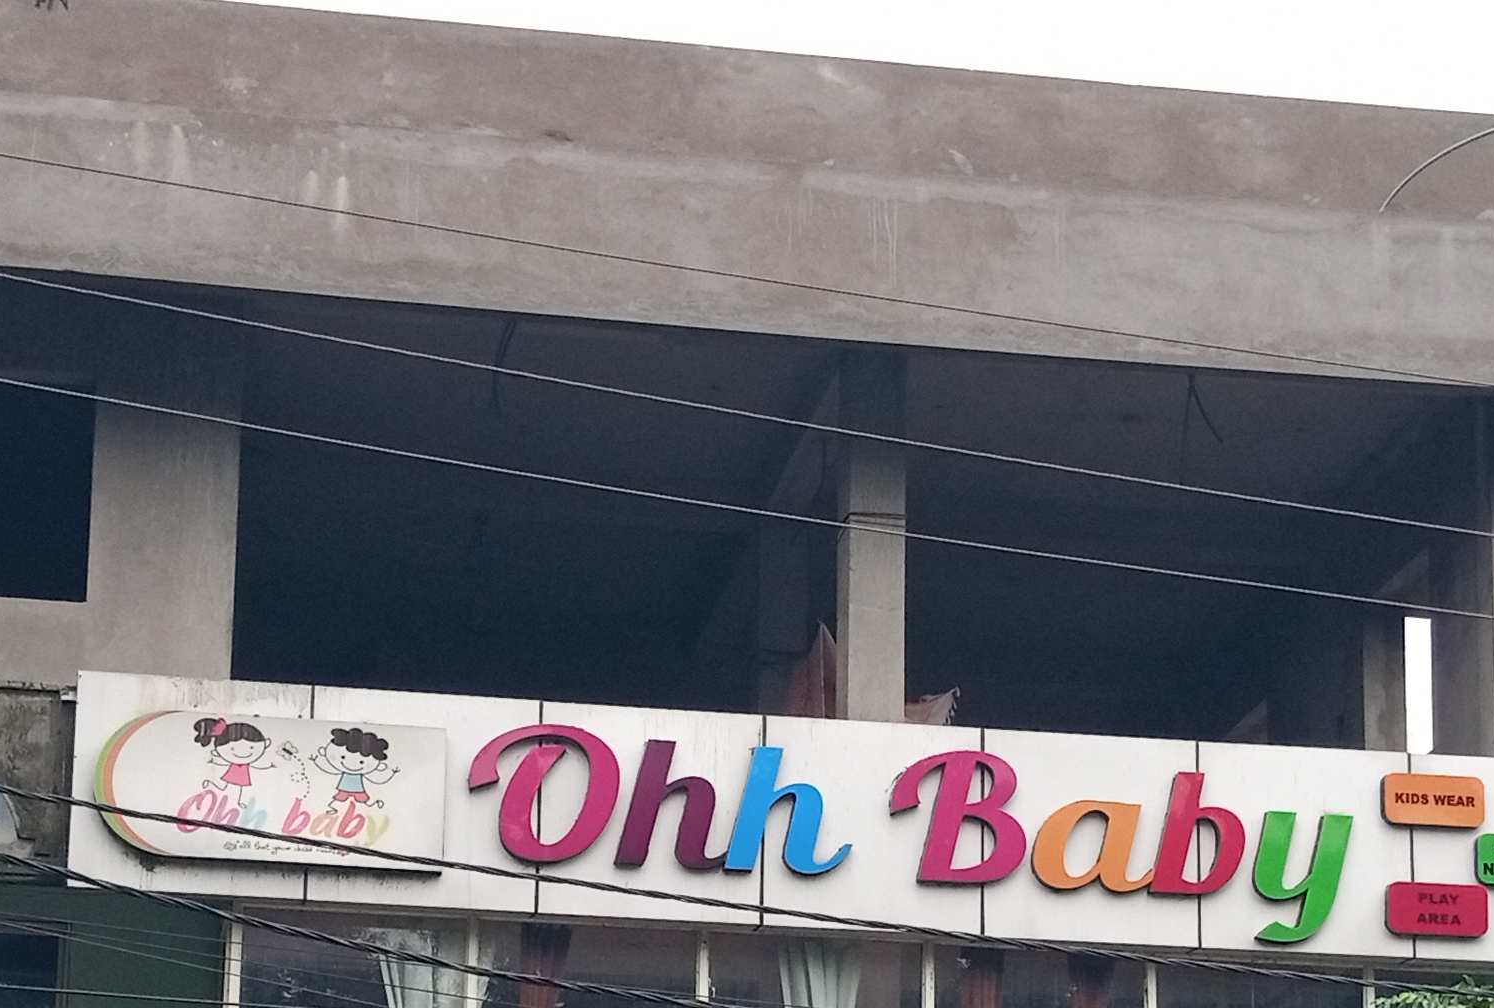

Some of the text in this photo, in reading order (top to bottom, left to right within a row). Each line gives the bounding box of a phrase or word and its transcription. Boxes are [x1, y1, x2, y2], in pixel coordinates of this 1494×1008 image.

[1394, 792, 1476, 808] KIDS WEAR
[176, 789, 268, 832] Ohh
[468, 723, 1353, 943] Ohh Baby
[1417, 893, 1459, 905] PLAY
[1416, 912, 1461, 926] AREA
